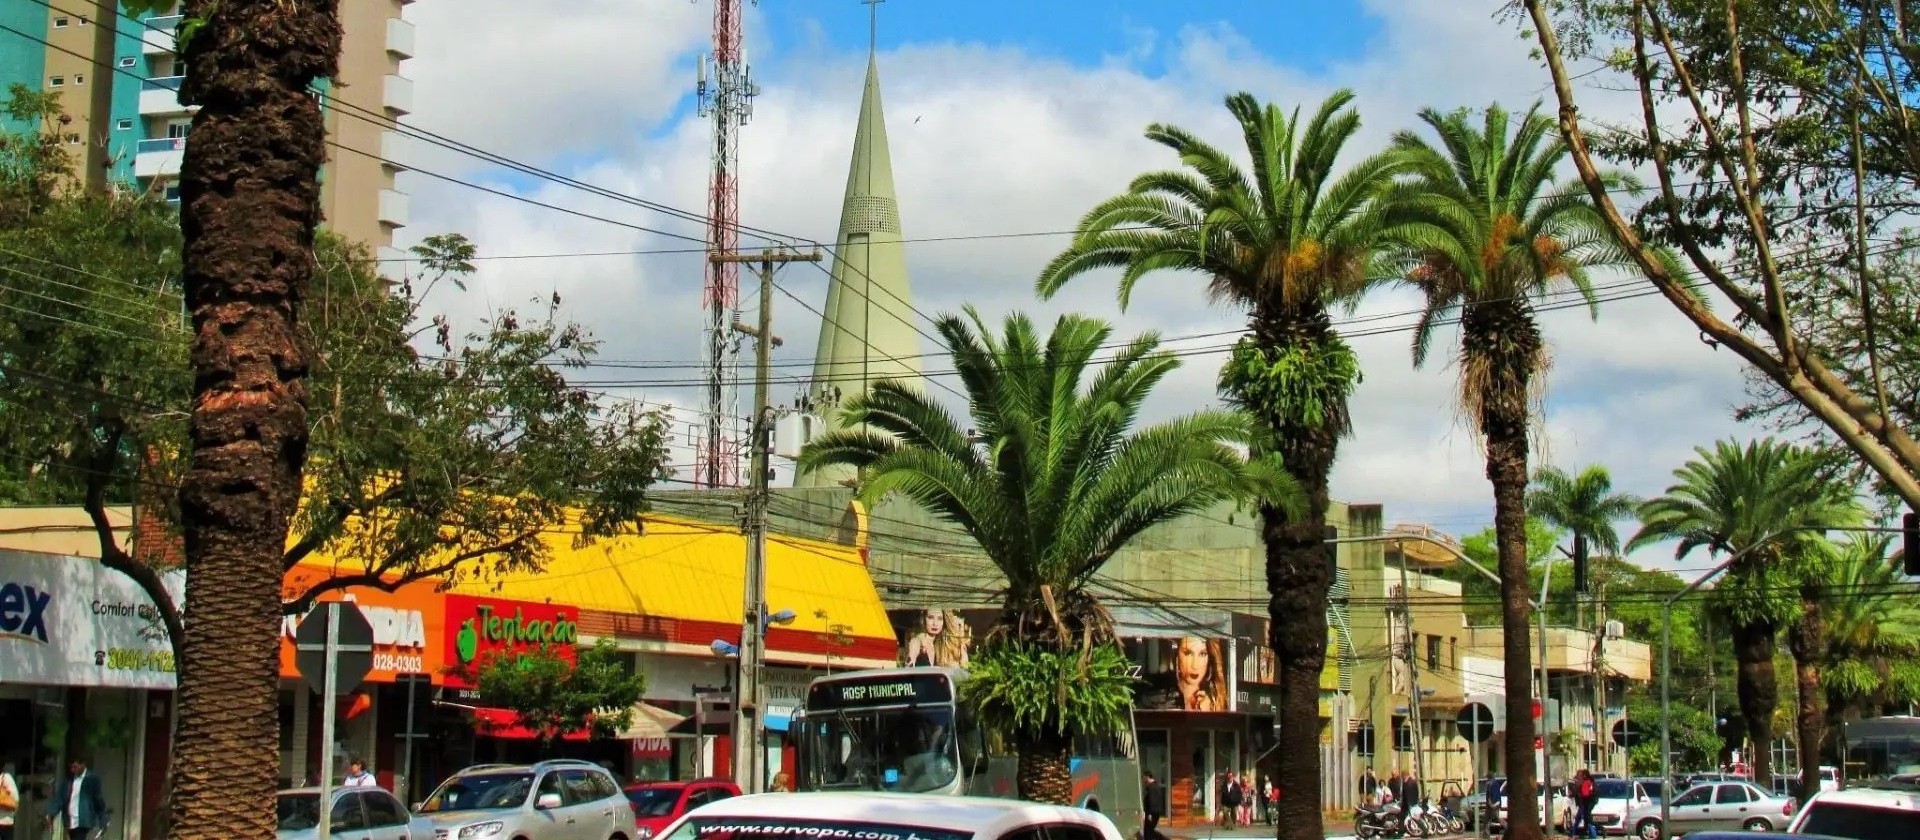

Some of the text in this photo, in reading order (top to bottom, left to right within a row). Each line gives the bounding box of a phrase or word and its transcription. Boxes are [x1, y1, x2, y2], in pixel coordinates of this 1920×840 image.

[92, 600, 134, 617] Comfort
[476, 604, 576, 648] Tentação
[107, 647, 176, 673] 3041-112
[842, 682, 916, 699] HOSP MUNICIPAL
[700, 825, 931, 840] www.servopa.com.b
